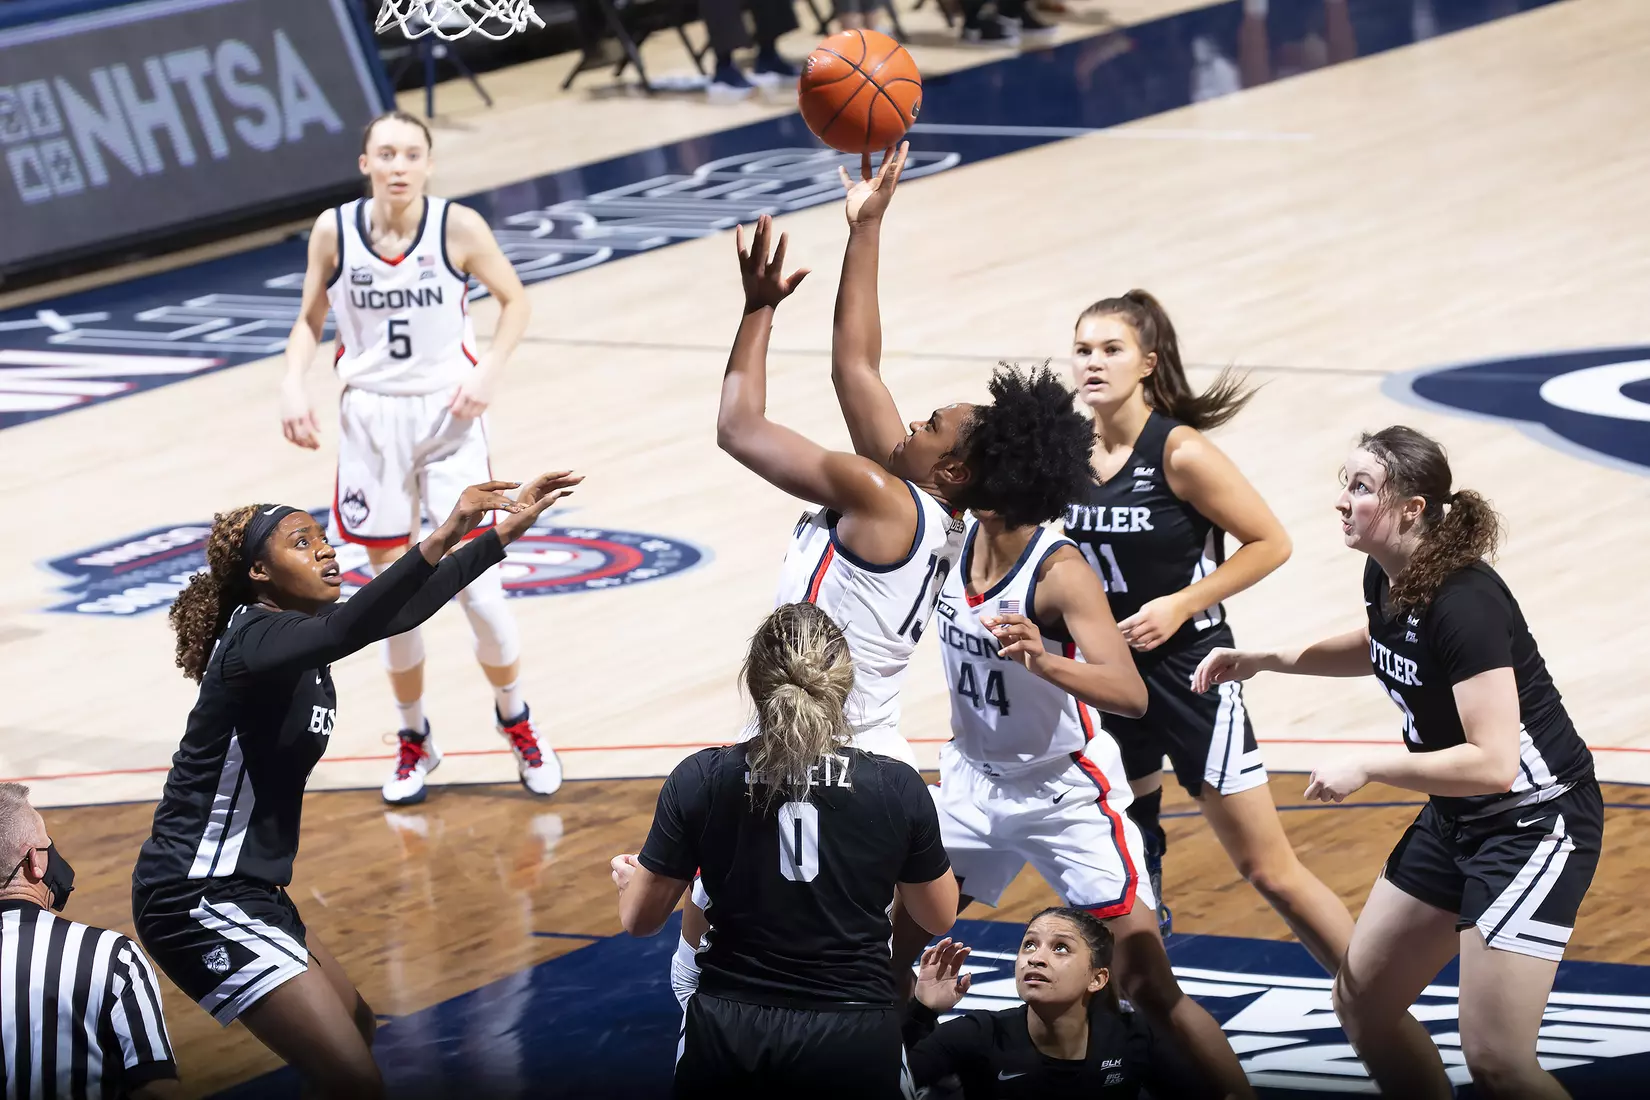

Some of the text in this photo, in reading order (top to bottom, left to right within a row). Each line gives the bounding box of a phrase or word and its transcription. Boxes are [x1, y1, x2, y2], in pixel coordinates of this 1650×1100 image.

[54, 28, 344, 186] NHTSA
[350, 286, 443, 309] UCONN
[388, 319, 412, 360] 5
[958, 661, 1009, 716] 44
[778, 801, 819, 882] 0
[1101, 1058, 1123, 1068] BLM
